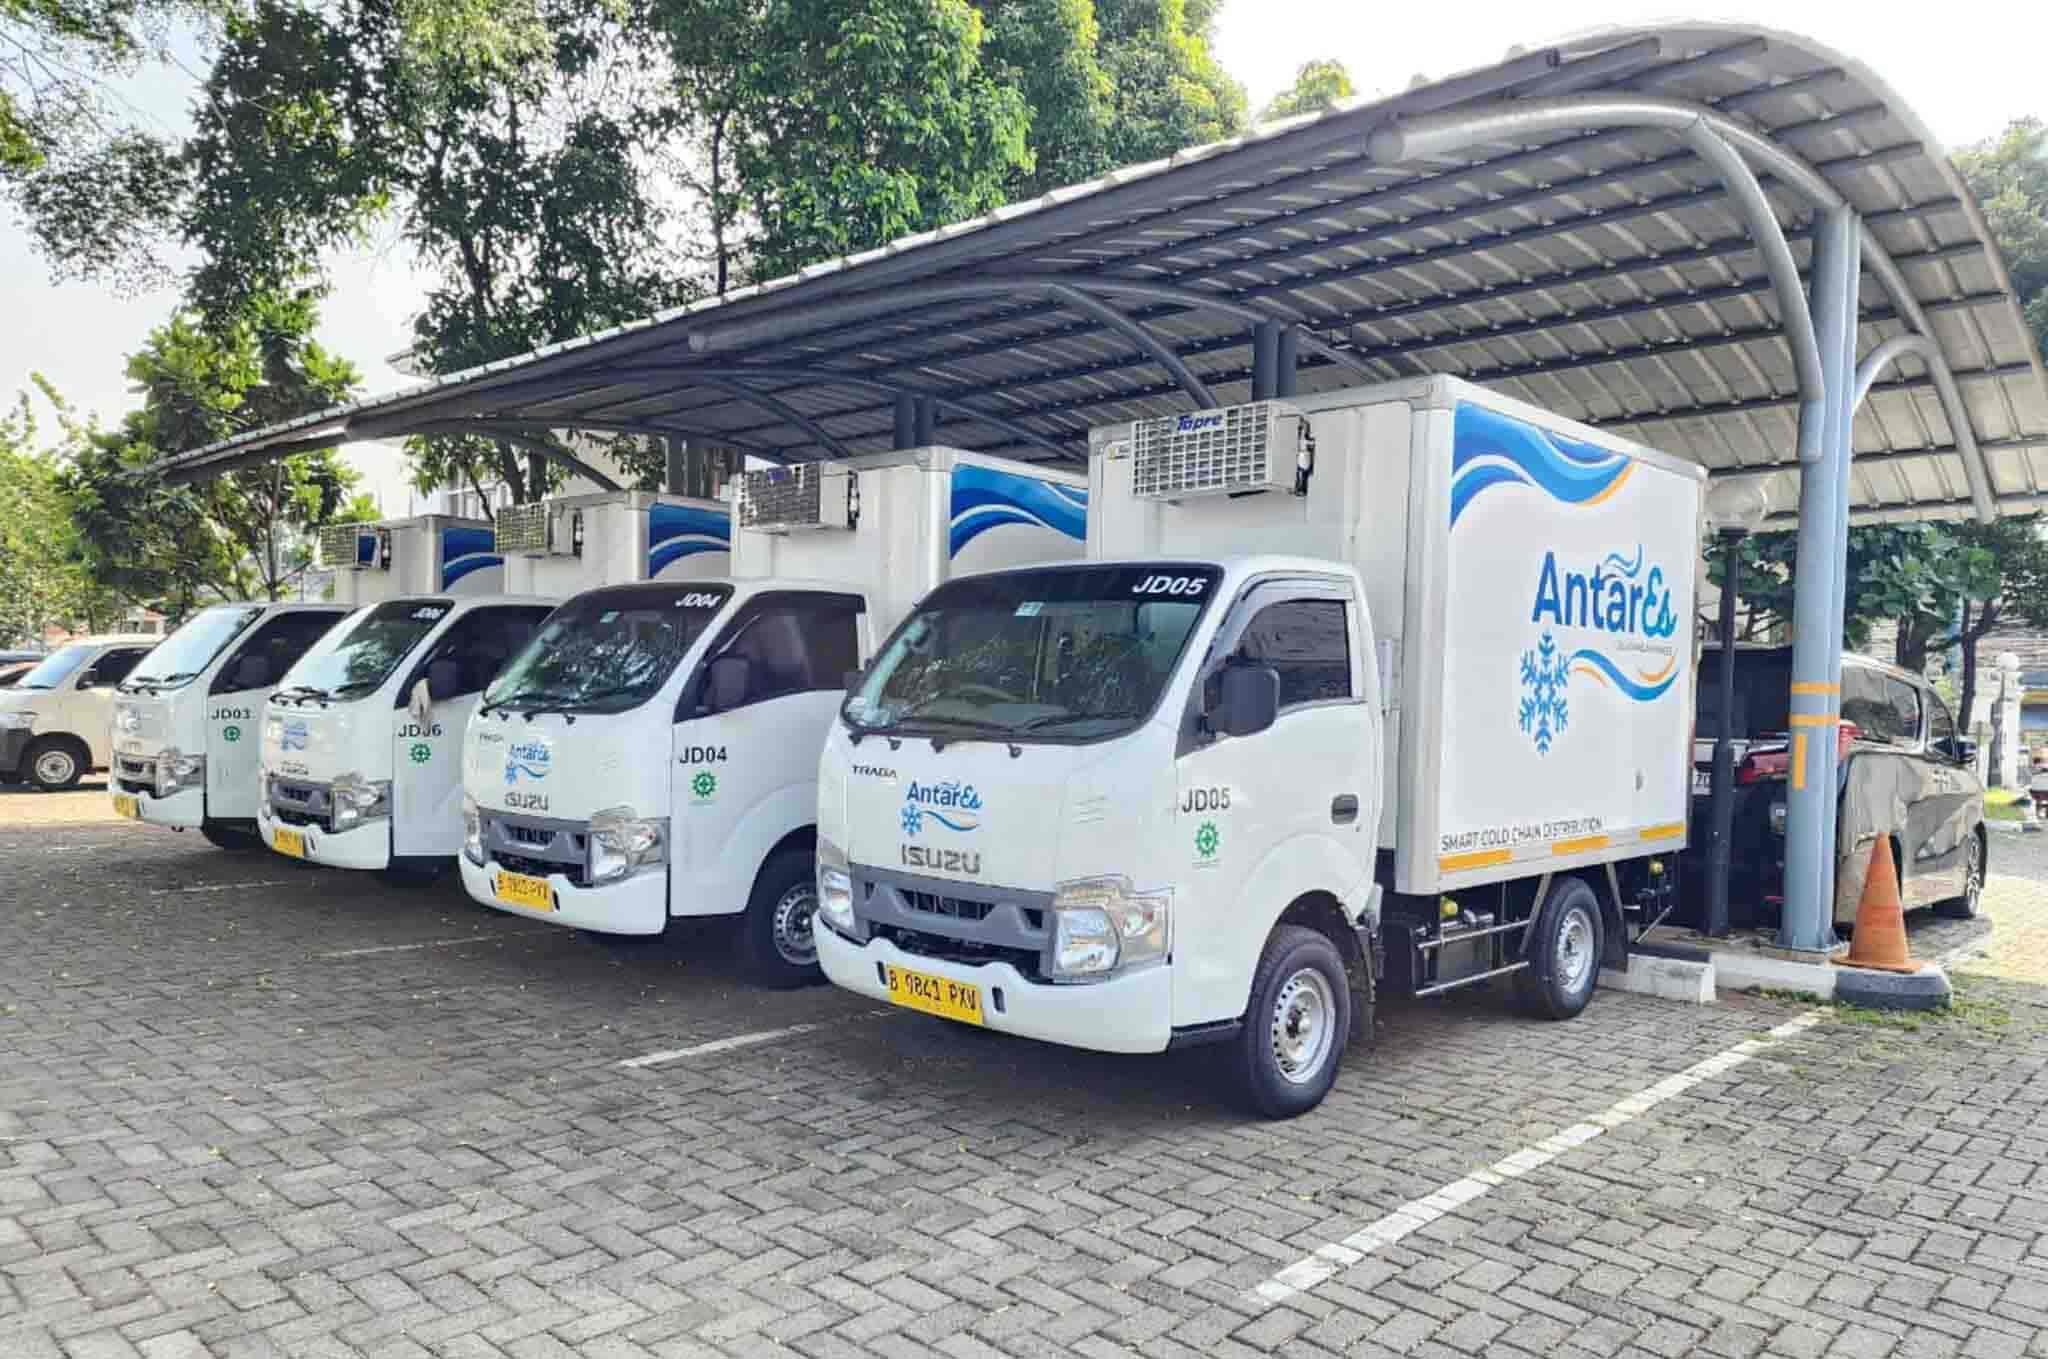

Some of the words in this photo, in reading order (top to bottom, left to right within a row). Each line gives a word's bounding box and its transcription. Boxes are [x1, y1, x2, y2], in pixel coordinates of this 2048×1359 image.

[1132, 575, 1208, 595] JD05
[211, 708, 251, 720] JD03
[679, 746, 728, 764] JD04
[1182, 787, 1231, 813] JD05
[1441, 832, 1479, 850] SMART
[1481, 827, 1510, 846] COLD
[902, 843, 981, 876] ISUZU
[889, 969, 898, 991] B
